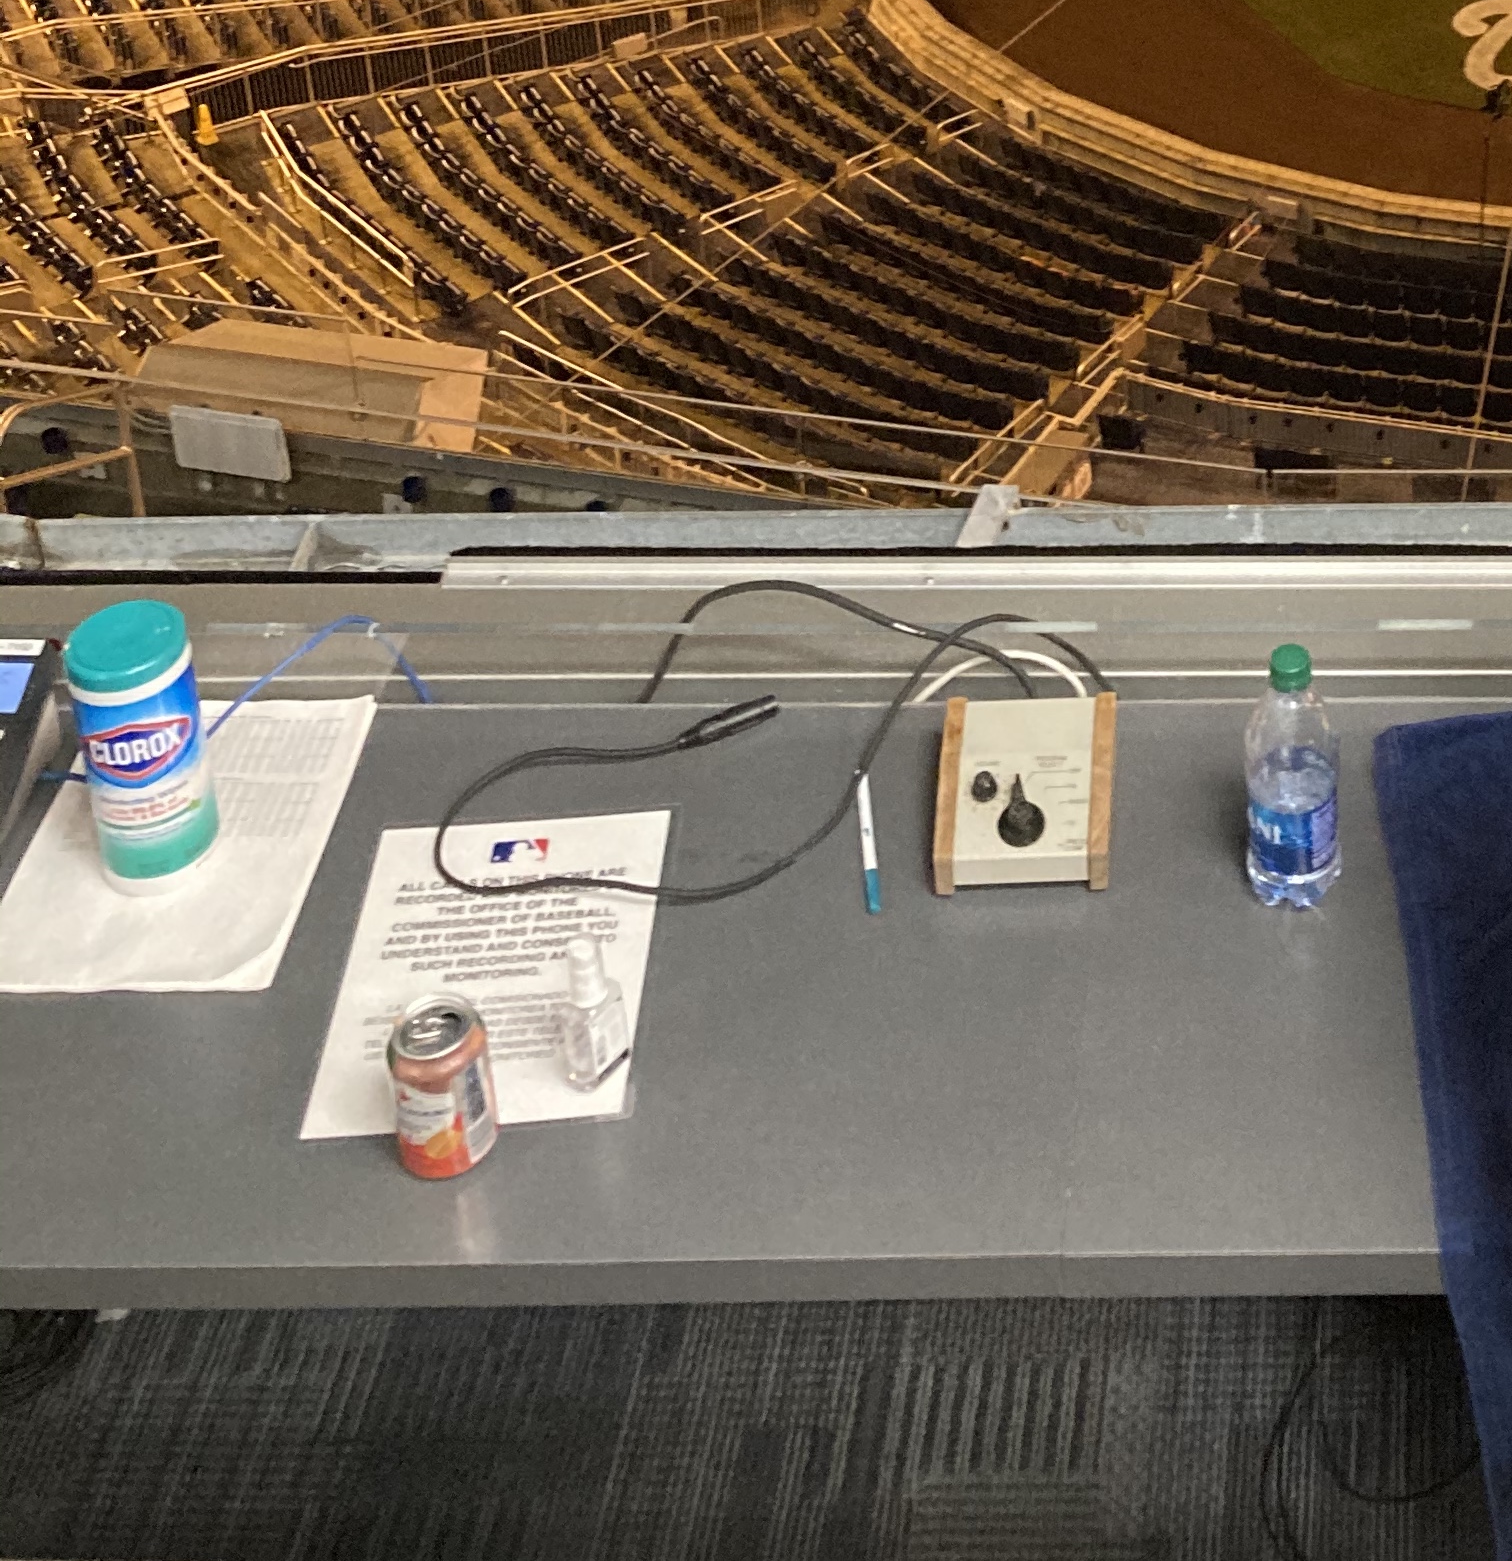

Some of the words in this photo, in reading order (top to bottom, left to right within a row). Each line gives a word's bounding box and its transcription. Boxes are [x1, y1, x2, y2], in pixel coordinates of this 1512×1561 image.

[88, 722, 181, 766] CLOROX
[398, 880, 427, 893] ALL
[437, 905, 464, 916] THE
[468, 901, 522, 915] OFFICE
[525, 899, 548, 911] OF
[550, 897, 579, 908] THE
[510, 913, 532, 924] OF
[384, 936, 417, 946] AND
[420, 933, 442, 944] BY
[496, 927, 528, 939] THIS
[531, 923, 583, 935] PHONE
[587, 920, 618, 931] YOU
[485, 941, 518, 953] AND
[410, 959, 454, 972] SUCH
